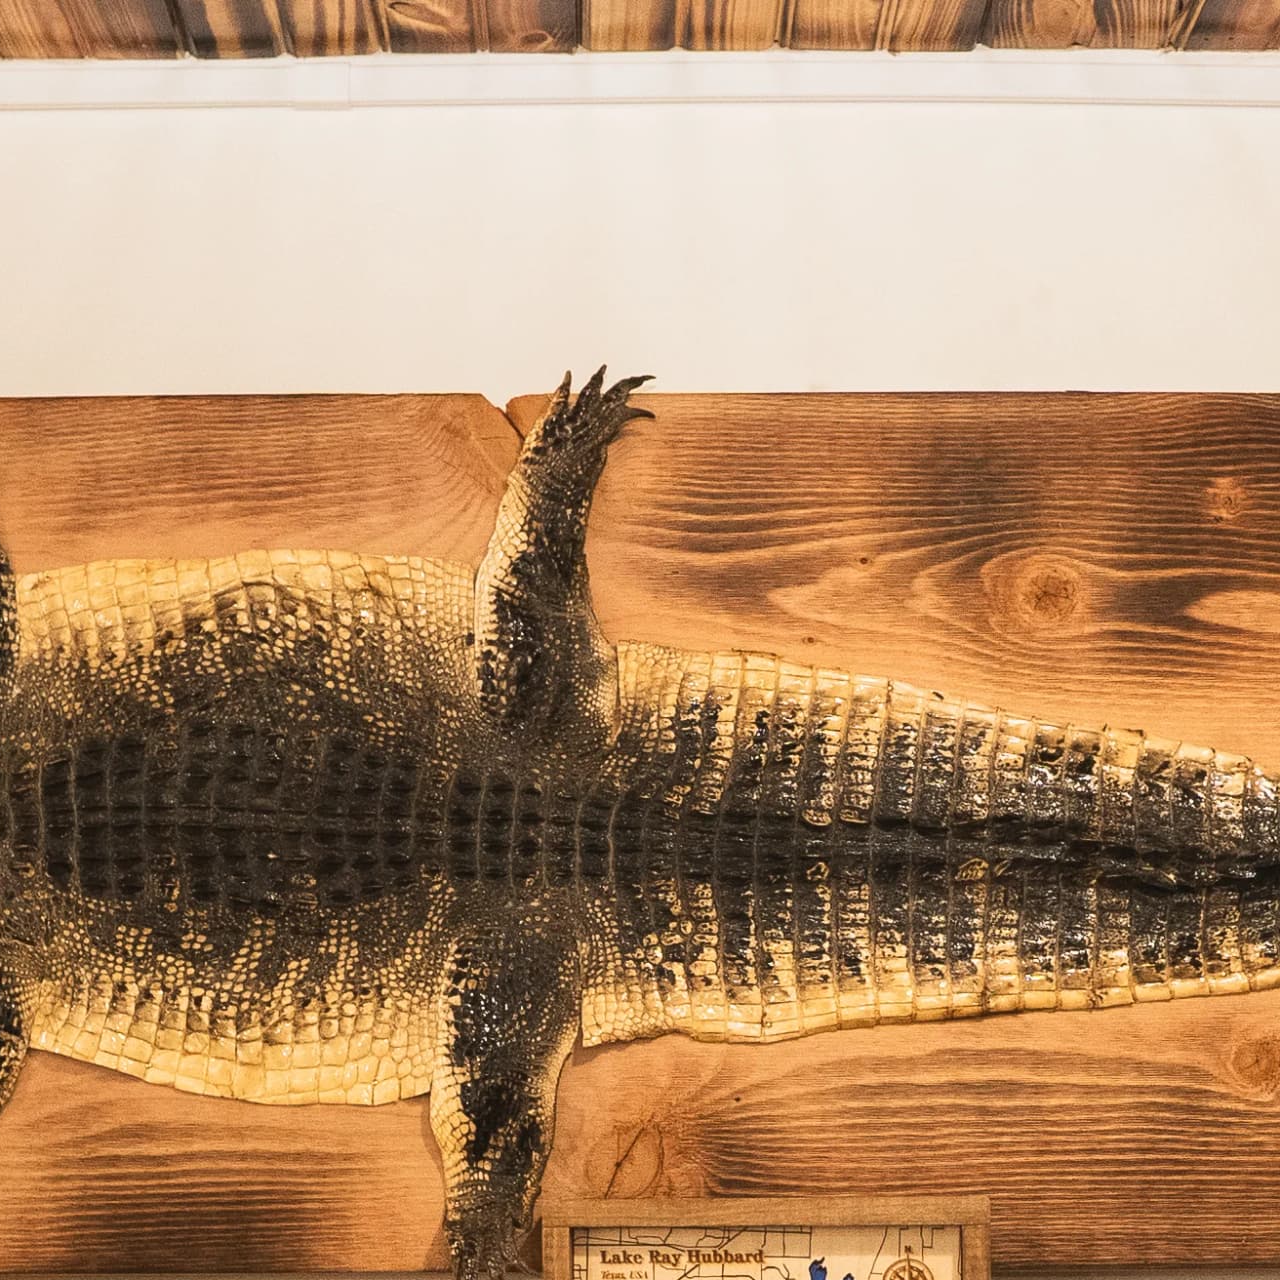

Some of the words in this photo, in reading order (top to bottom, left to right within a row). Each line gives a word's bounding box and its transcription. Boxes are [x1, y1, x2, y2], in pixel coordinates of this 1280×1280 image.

[600, 1250, 643, 1264] Lake
[648, 1250, 682, 1268] Ray
[687, 1250, 764, 1264] Hubbard
